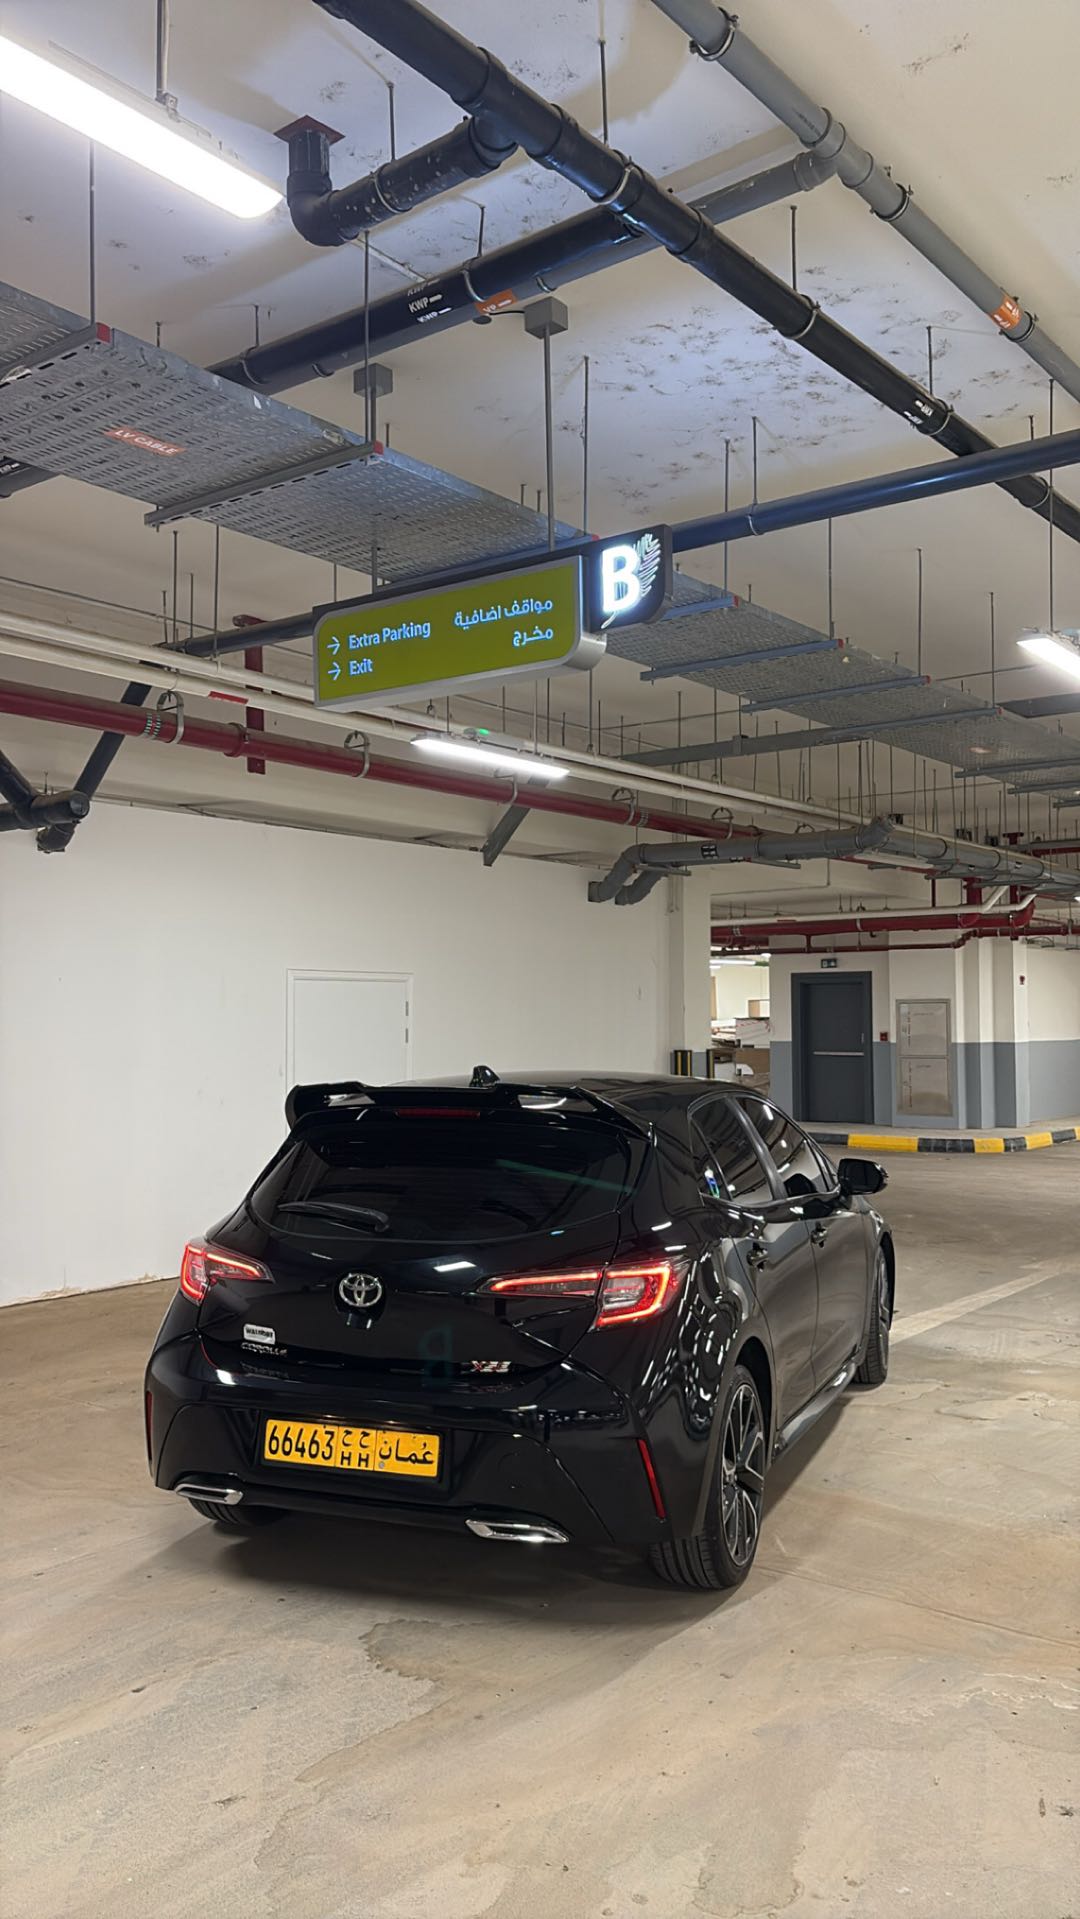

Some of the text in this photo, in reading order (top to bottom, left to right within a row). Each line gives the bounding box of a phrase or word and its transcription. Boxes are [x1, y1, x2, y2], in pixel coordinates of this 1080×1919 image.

[408, 296, 429, 313] KWP
[115, 430, 177, 454] LV CABLE
[602, 544, 641, 616] B
[454, 598, 553, 630] مواقف اضافية
[349, 622, 431, 650] Extra Parking
[513, 625, 554, 647] مخرج
[349, 658, 373, 675] Exit
[268, 1424, 335, 1461] 66463
